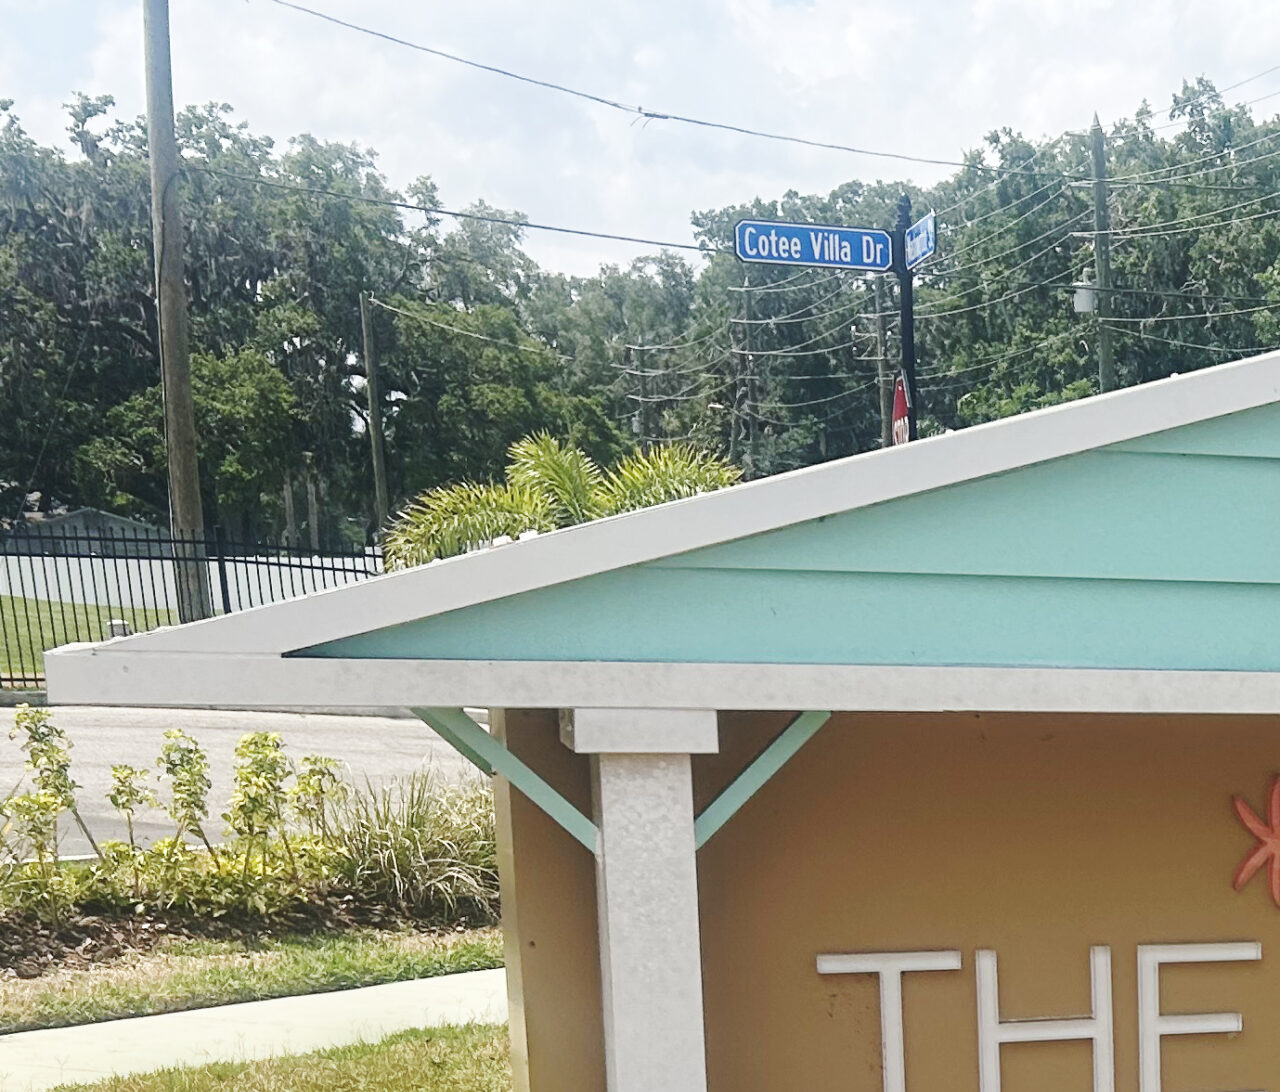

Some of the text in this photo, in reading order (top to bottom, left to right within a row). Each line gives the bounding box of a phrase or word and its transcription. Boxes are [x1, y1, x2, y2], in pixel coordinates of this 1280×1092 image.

[744, 227, 801, 259] Cotee
[810, 231, 851, 263] Villa
[862, 235, 884, 265] Dr
